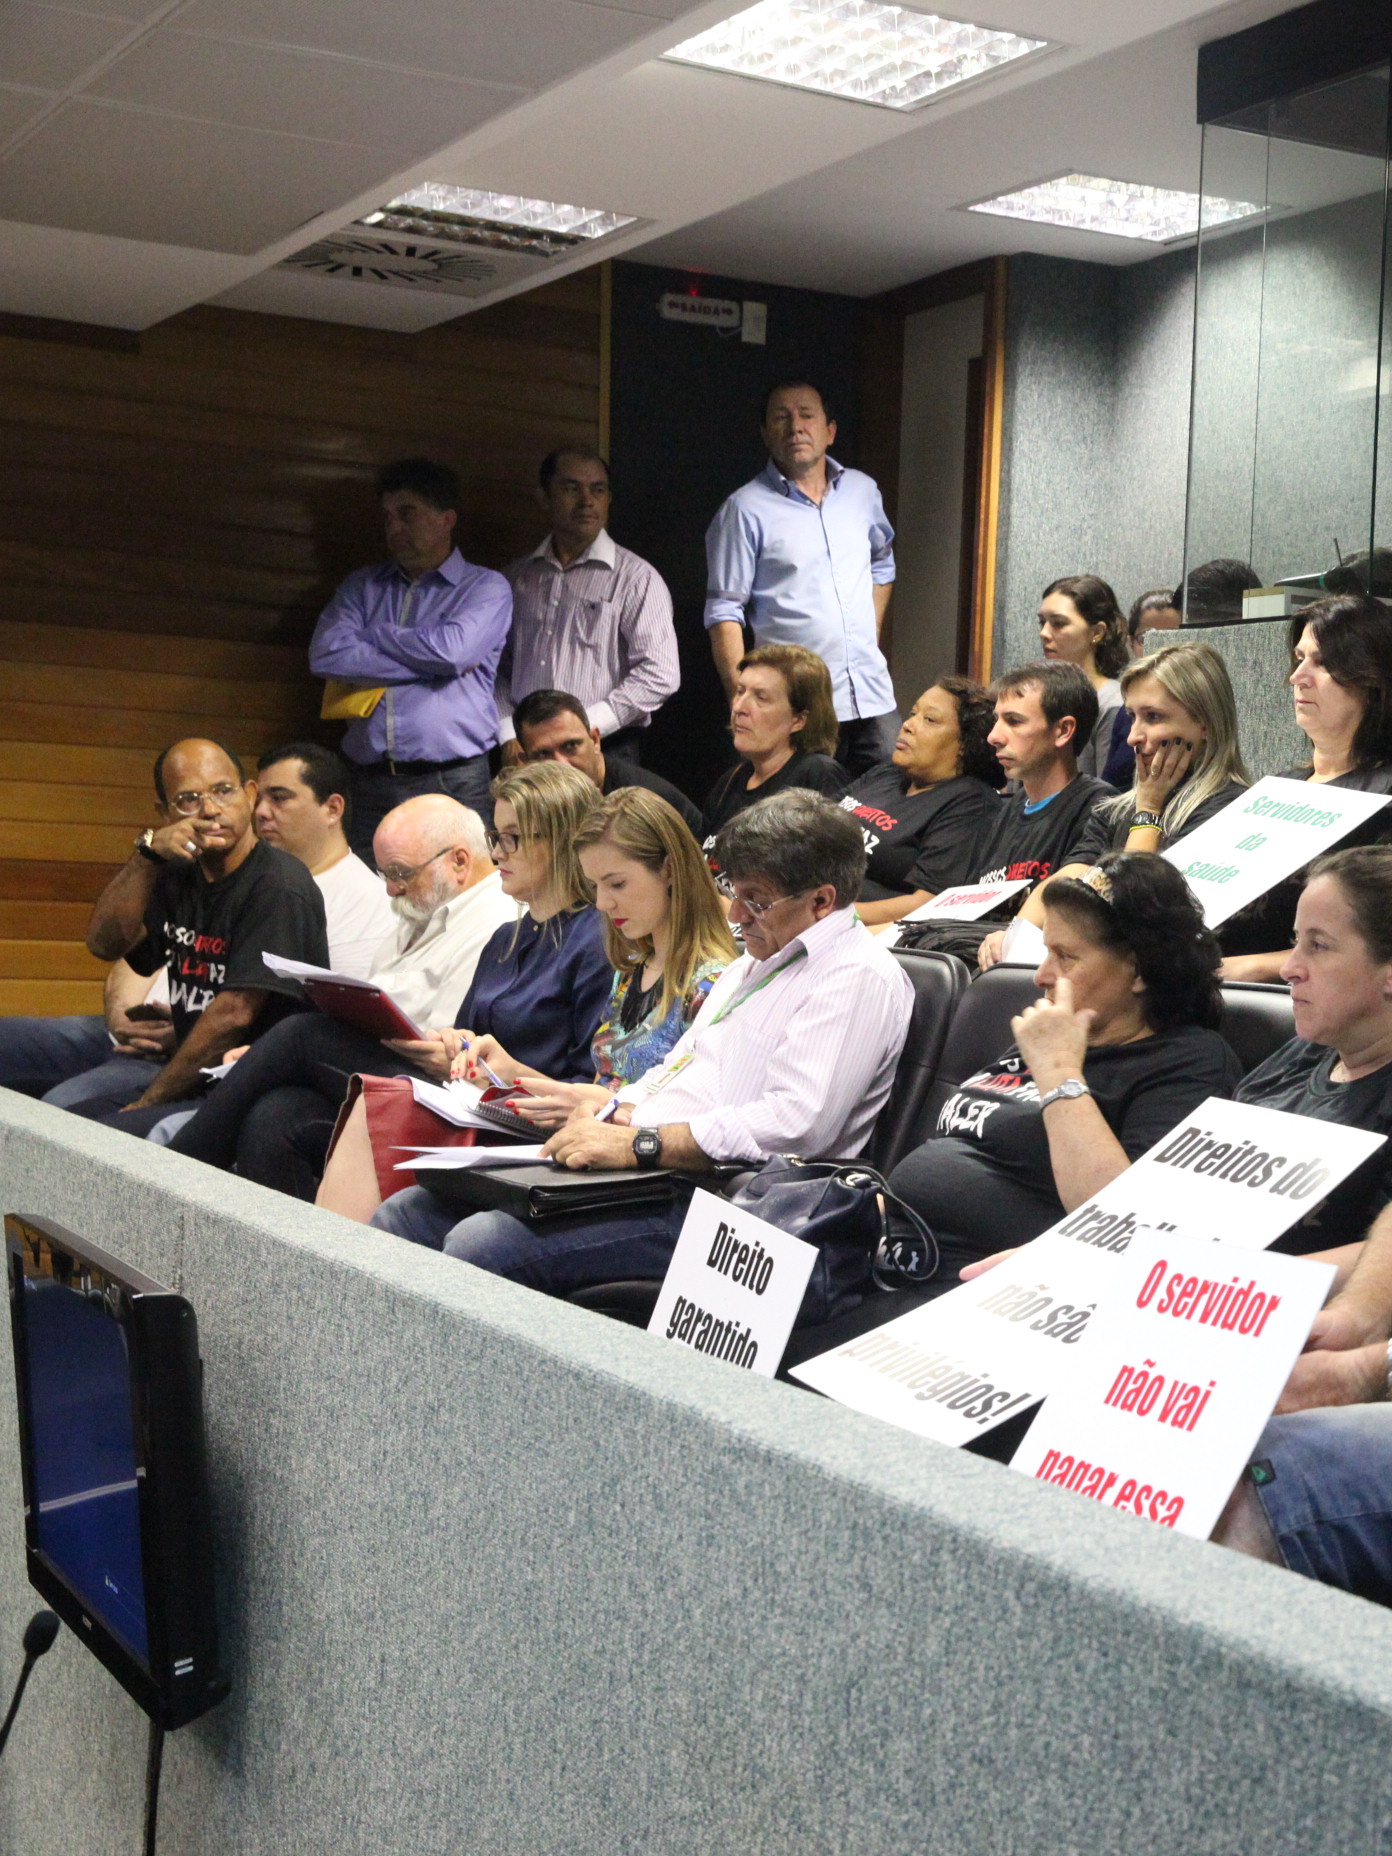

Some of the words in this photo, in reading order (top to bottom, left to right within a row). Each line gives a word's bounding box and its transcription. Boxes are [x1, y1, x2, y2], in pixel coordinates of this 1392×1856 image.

[1235, 833, 1268, 851] da
[1243, 796, 1343, 828] Servidores
[1182, 861, 1240, 884] saúde
[1152, 1127, 1288, 1189] Direitos
[1268, 1157, 1331, 1200] do
[706, 1221, 774, 1296] Direito
[976, 1283, 1054, 1323] não
[1136, 1259, 1168, 1309] O
[1156, 1276, 1282, 1338] servidor
[837, 1333, 1033, 1425] privilégios!
[1103, 1358, 1166, 1417] não
[1157, 1380, 1217, 1432] vai
